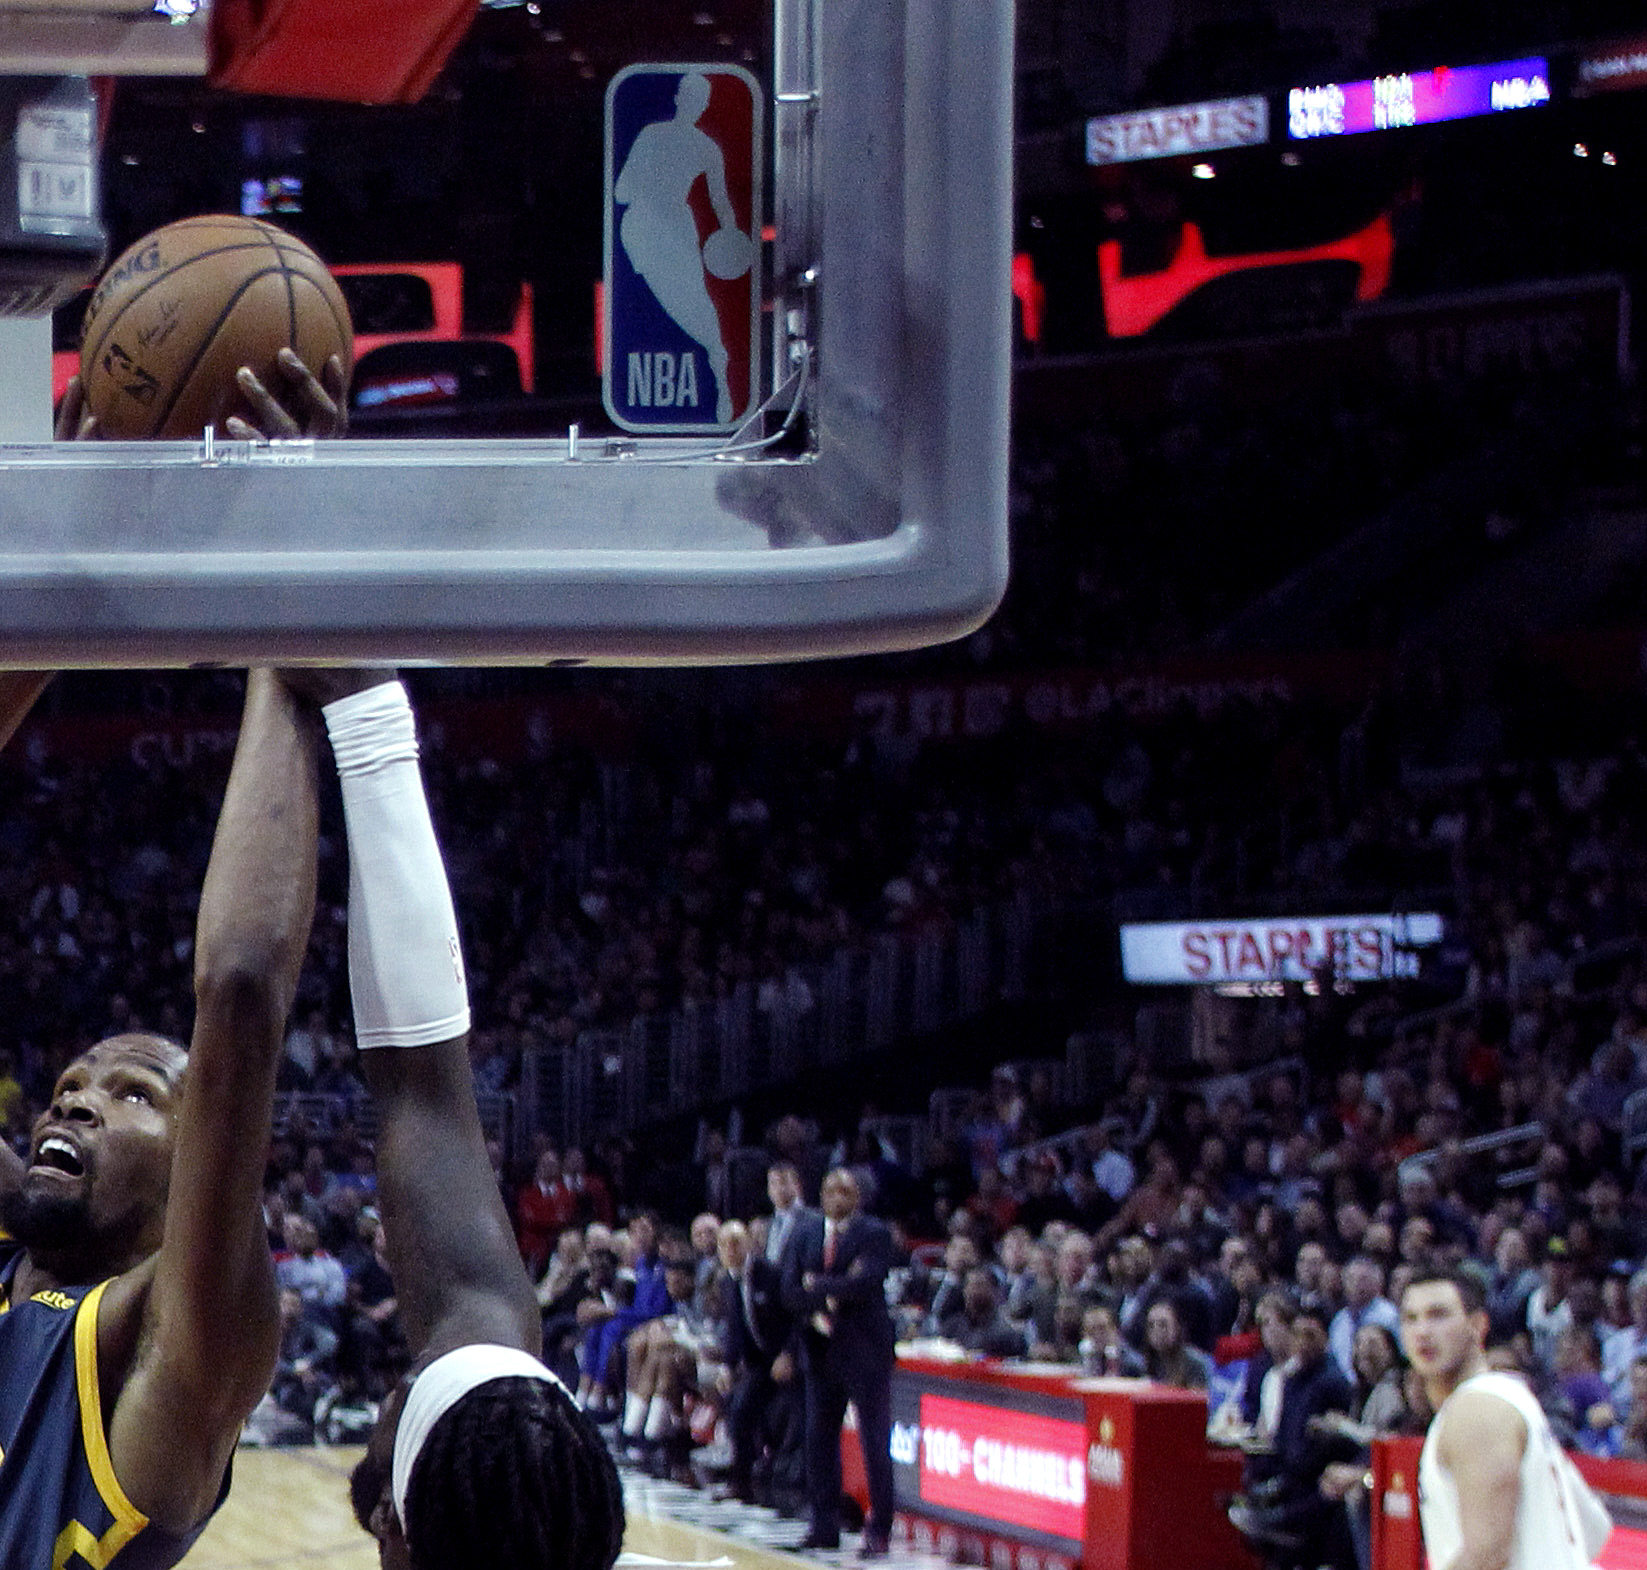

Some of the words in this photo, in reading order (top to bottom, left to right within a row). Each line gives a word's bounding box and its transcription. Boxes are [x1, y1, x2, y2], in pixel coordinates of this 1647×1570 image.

[1092, 102, 1261, 163] STAPLES
[627, 352, 699, 408] NBA
[972, 1435, 1086, 1505] CHANNELS
